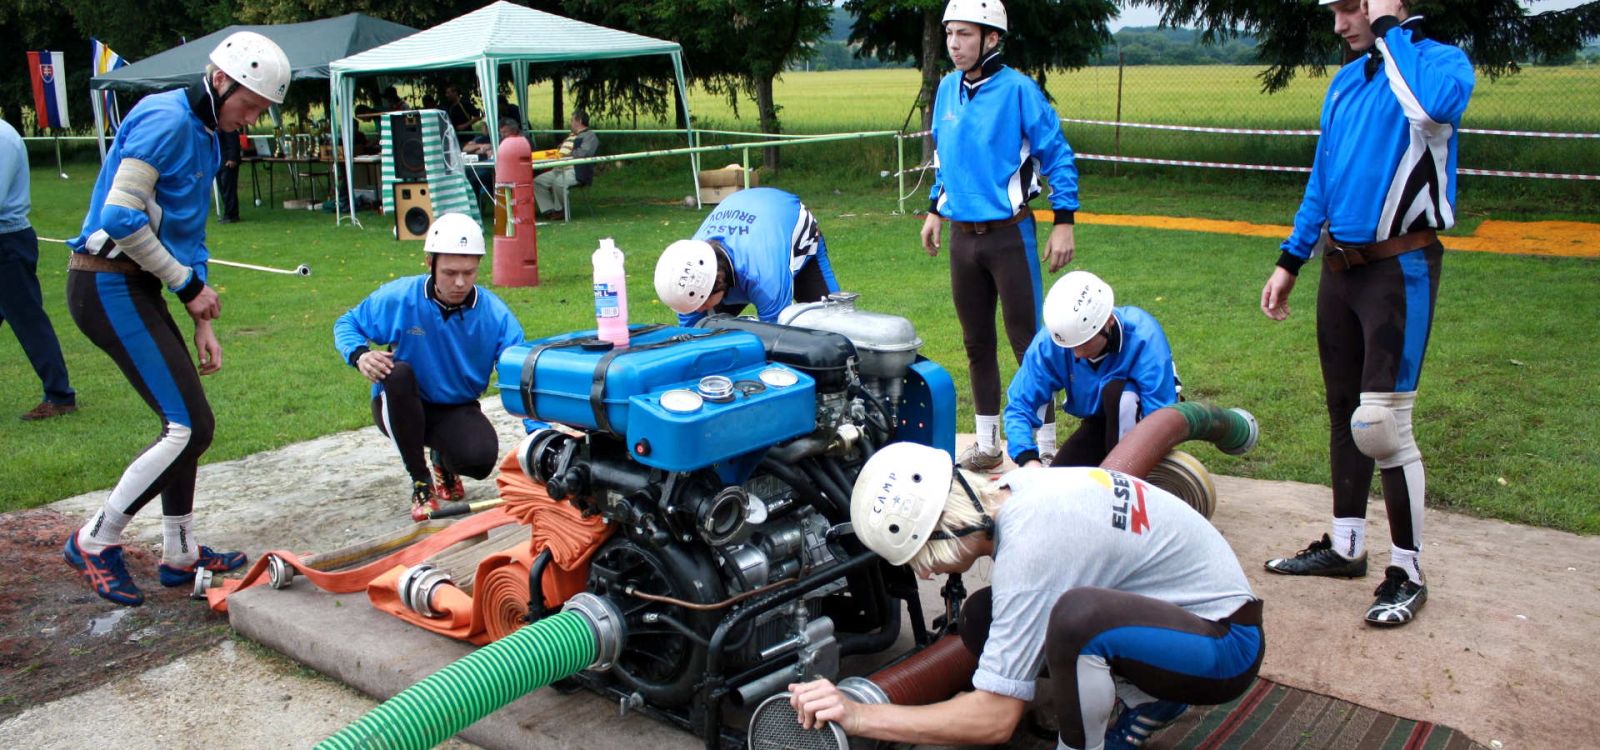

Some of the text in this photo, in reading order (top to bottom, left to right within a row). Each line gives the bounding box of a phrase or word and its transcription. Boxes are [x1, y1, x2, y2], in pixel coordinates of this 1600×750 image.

[709, 209, 757, 224] BRUMOV
[678, 261, 692, 288] CAMP
[1073, 284, 1088, 312] CAMP
[873, 472, 896, 514] CAMP
